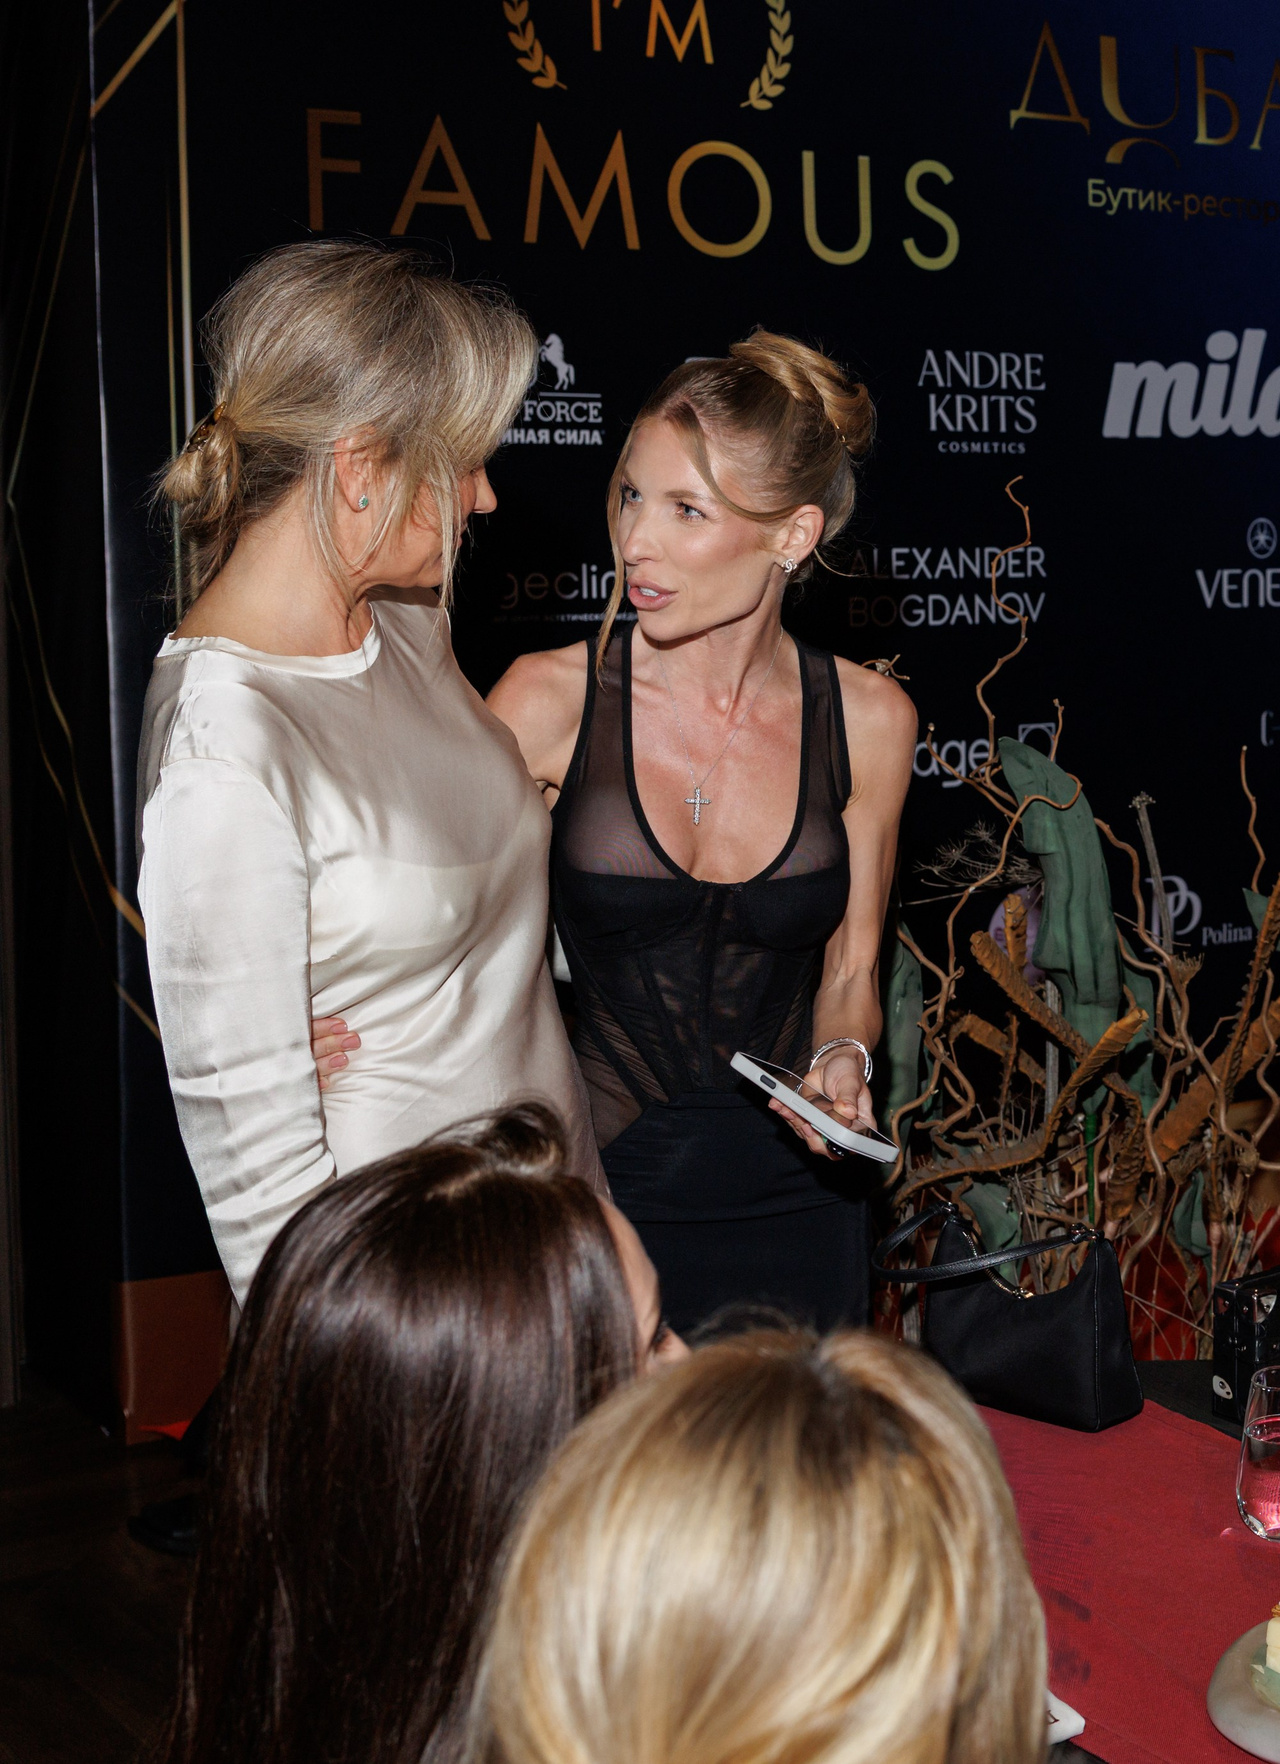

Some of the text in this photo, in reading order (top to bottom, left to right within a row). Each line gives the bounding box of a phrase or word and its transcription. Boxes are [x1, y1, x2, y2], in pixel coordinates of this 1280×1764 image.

[306, 107, 960, 272] FAMOUS
[918, 348, 1046, 392] ANDRE
[522, 400, 604, 424] FORCE
[929, 392, 1038, 435] KRITS
[553, 428, 604, 446] СИЛА
[937, 440, 1027, 455] COSMETICS
[850, 545, 1048, 581] ALEXANDER
[848, 591, 1047, 629] BOGDANOV
[912, 738, 994, 789] age
[1202, 921, 1253, 948] Polina
